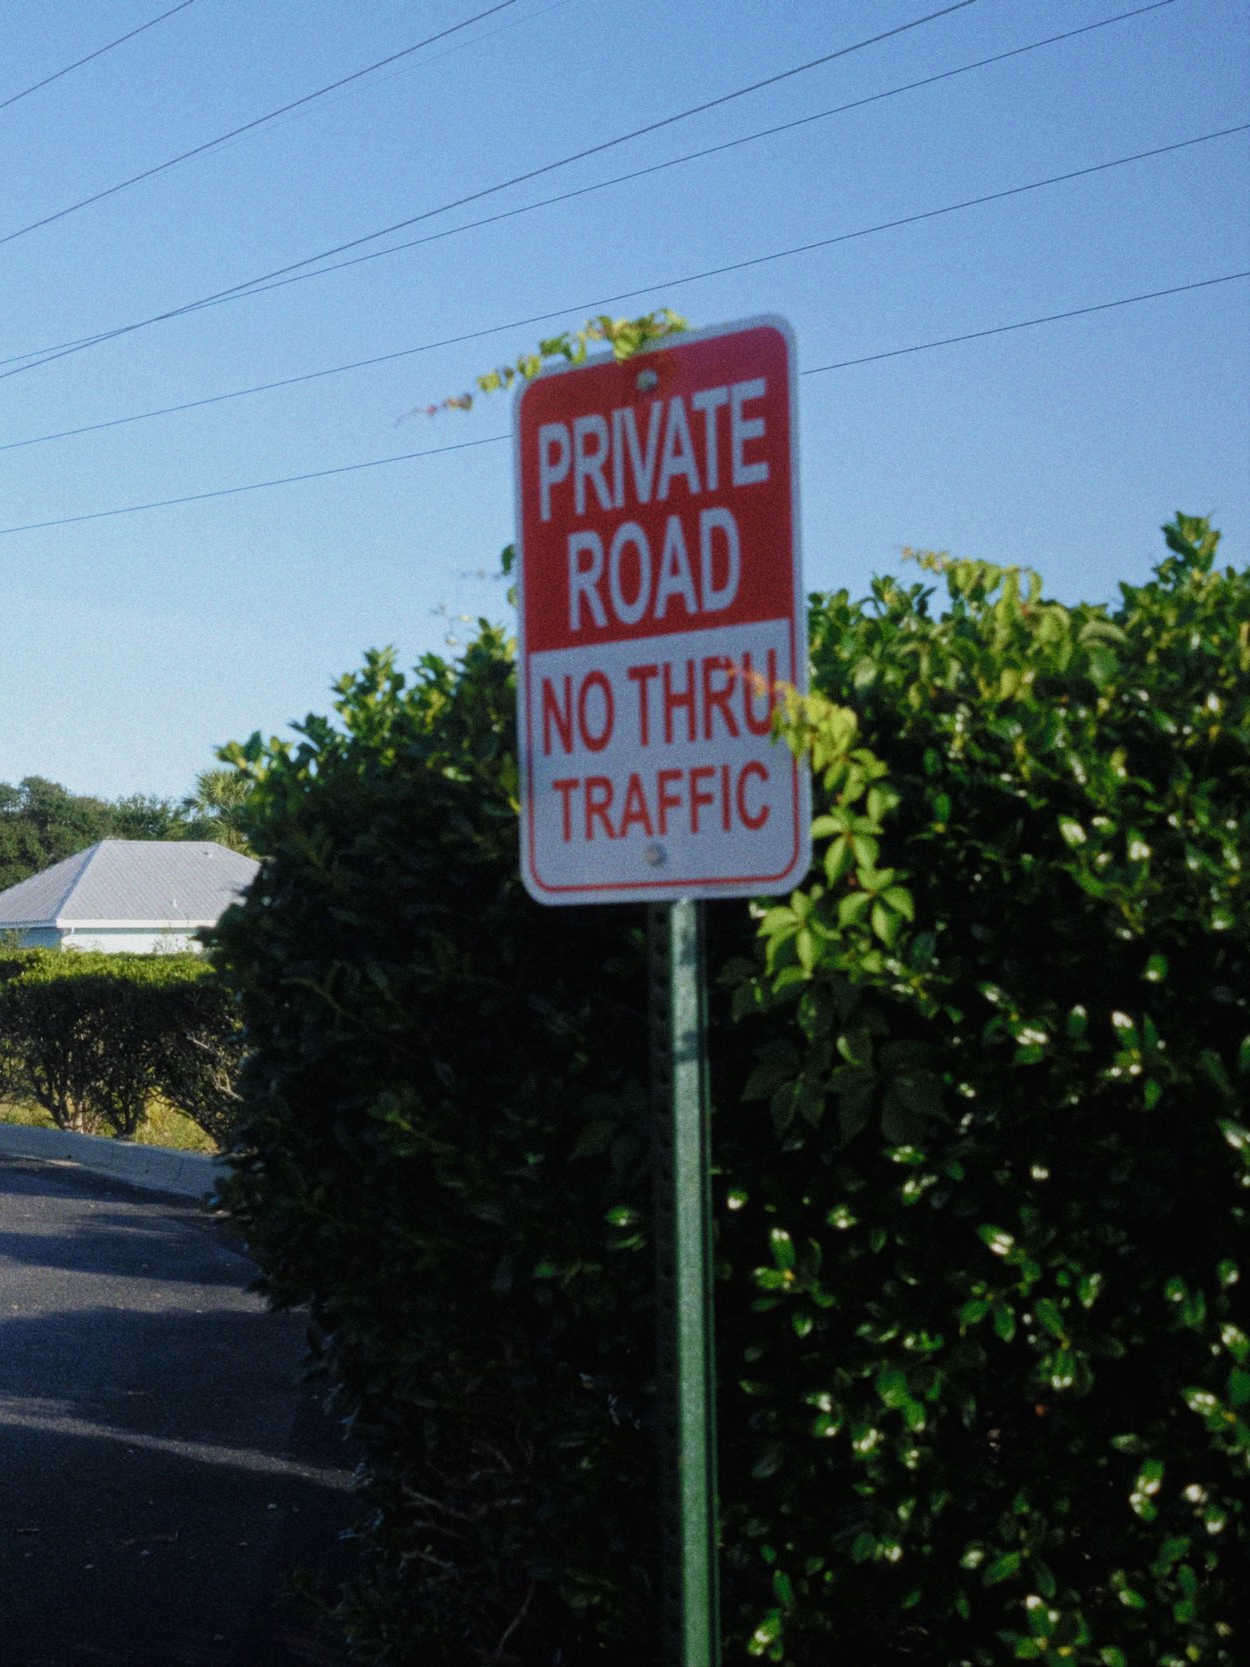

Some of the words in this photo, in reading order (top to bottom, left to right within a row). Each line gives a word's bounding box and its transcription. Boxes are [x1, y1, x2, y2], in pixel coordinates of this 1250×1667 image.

[538, 377, 770, 522] PRIVATE
[567, 507, 741, 632] ROAD
[541, 669, 615, 757] NO
[627, 648, 778, 747] THRU
[552, 761, 771, 842] TRAFFIC
